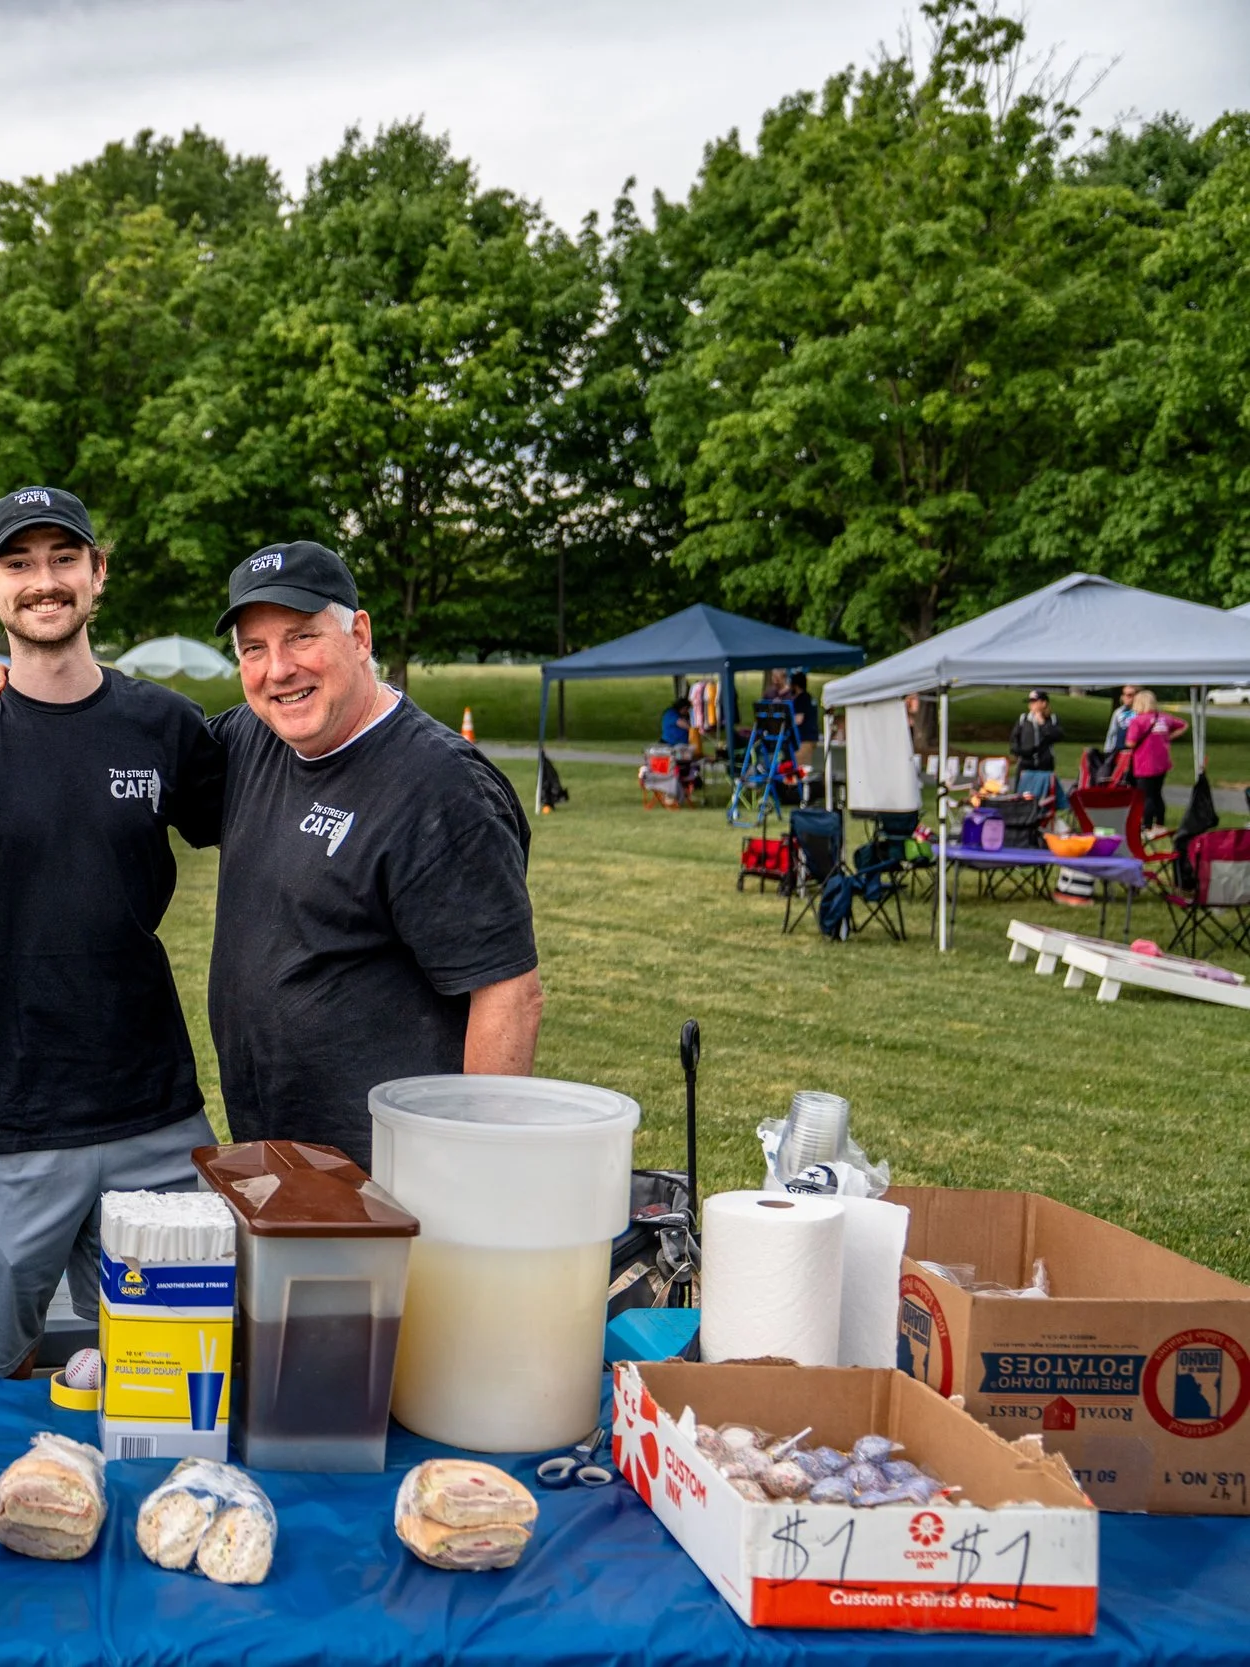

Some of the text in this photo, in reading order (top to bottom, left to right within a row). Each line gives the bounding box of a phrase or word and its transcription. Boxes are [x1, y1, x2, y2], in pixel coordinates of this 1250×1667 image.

[109, 768, 152, 778] 7TH STREET
[111, 779, 155, 798] CAFE
[310, 802, 348, 820] 7TH STREET
[299, 813, 345, 840] CAFE
[121, 1286, 147, 1296] SUNSET
[206, 1281, 229, 1289] STRAWS
[998, 1356, 1134, 1376] POTATOES
[1180, 1352, 1219, 1366] IDAHO
[1056, 1377, 1134, 1391] PREMIUM
[986, 1405, 1134, 1421] ROYAL CREST
[665, 1445, 707, 1509] CUSTOM
[1097, 1470, 1118, 1482] 50
[1163, 1471, 1246, 1486] U.S. NO. 1
[665, 1472, 682, 1511] INK
[903, 1550, 949, 1561] CUSTOM
[916, 1561, 935, 1570] INK
[829, 1589, 893, 1606] Custom
[896, 1591, 957, 1609] t-shirts
[959, 1593, 973, 1609] &
